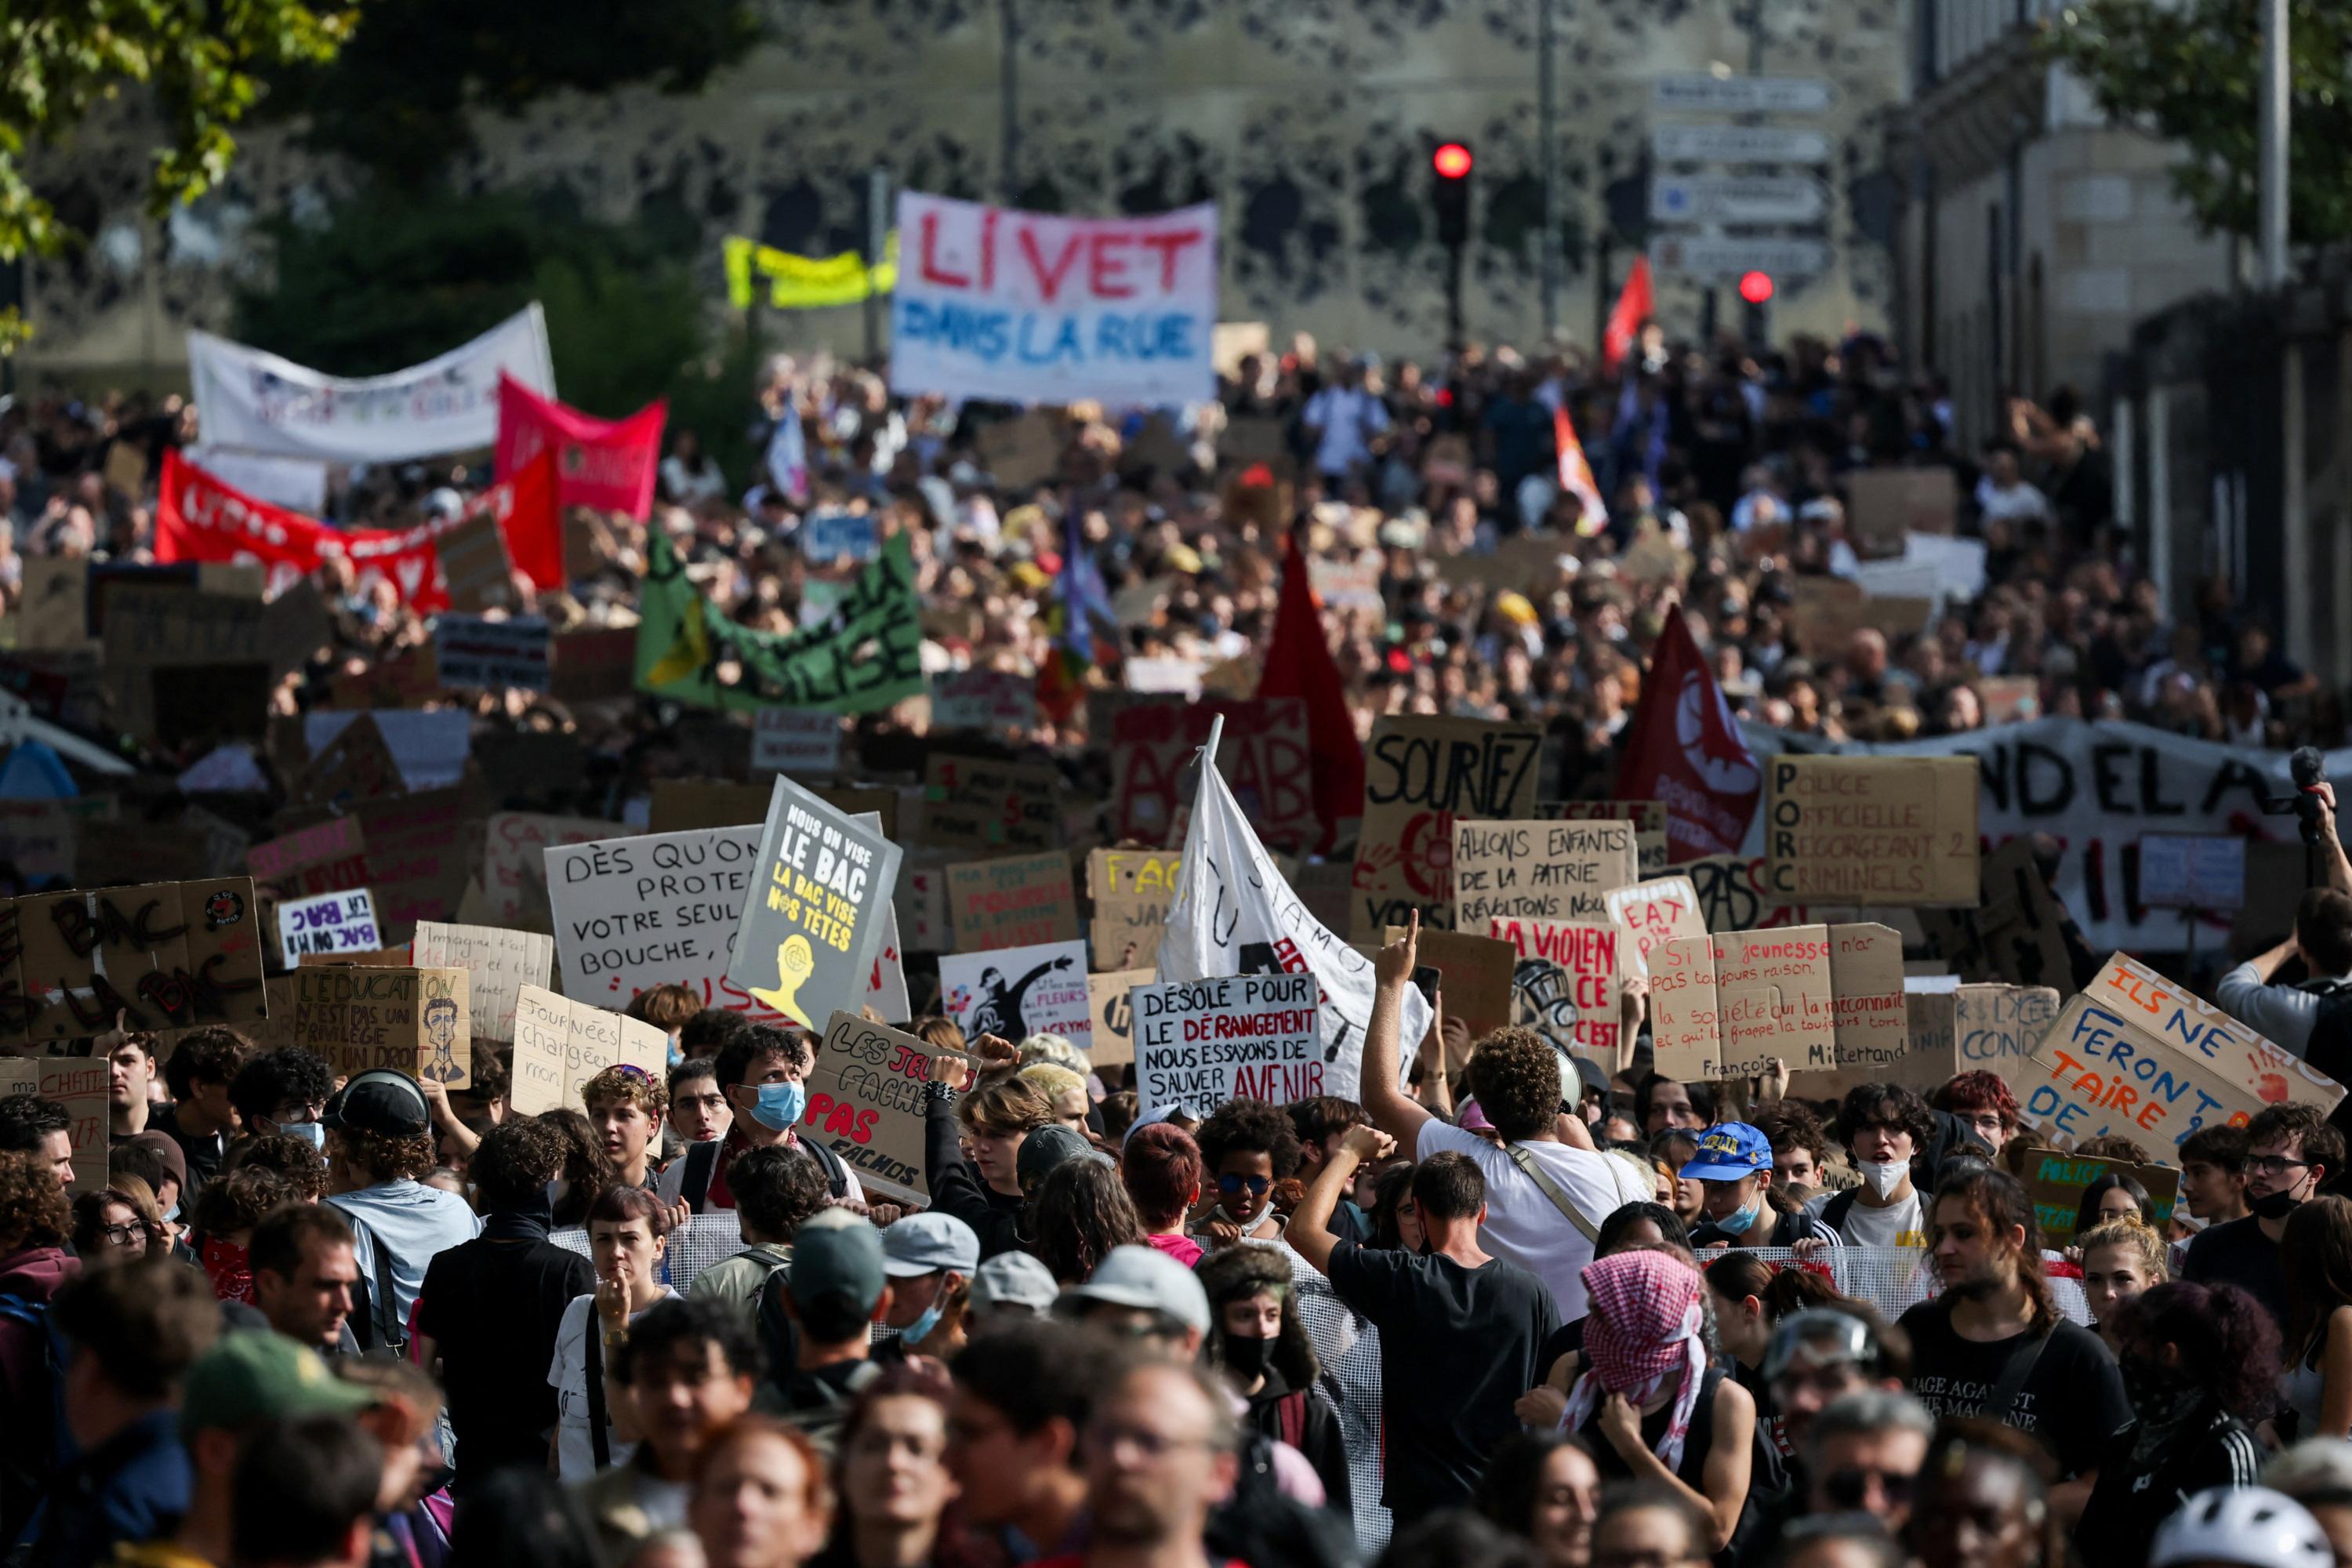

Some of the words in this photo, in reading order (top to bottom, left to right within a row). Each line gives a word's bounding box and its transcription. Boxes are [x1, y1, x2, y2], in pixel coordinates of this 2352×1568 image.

[920, 205, 1204, 304] LIVET
[902, 299, 1009, 362] DANS
[1018, 315, 1083, 364] LA
[1099, 315, 1194, 359] RUE
[1368, 731, 1541, 820] SOURIEZ
[787, 804, 822, 838] NOUS
[823, 826, 843, 851] ON
[844, 837, 873, 869] VISE
[1456, 828, 1530, 862] ALLONS
[1548, 827, 1628, 858] ENFANTS
[565, 843, 633, 883] DÈS
[779, 824, 811, 872] LE
[814, 845, 868, 905] BAC
[1461, 871, 1491, 891] DE
[1497, 867, 1517, 889] LA
[1773, 864, 1924, 892] CRIMINELS
[637, 869, 753, 902] PROTE
[772, 861, 791, 889] LA
[793, 873, 824, 907] BAC
[826, 892, 858, 927] VISE
[292, 901, 343, 931] BAC
[1570, 892, 1607, 918] NOU
[1624, 899, 1684, 929] EAT
[50, 896, 191, 958] BAC
[337, 924, 375, 947] BAC
[572, 909, 662, 942] VOTRE
[803, 906, 852, 953] TÊTES
[487, 958, 503, 971] et
[1665, 938, 1692, 967] Si
[1706, 938, 1725, 960] la
[1742, 942, 1831, 964] jeunesse
[135, 953, 263, 1024] BAC
[1036, 990, 1087, 1007] FLEURS
[1143, 980, 1232, 1017] DÉSOLÉ
[1245, 978, 1307, 1004] POUR
[1576, 975, 1608, 1009] CE
[1652, 971, 1687, 993] pas
[296, 1003, 347, 1024] N'EST
[350, 1005, 379, 1025] PAS
[385, 1008, 410, 1024] UN
[1658, 1002, 1675, 1025] la
[1691, 997, 1766, 1025] société
[1769, 1003, 1795, 1022] qui
[1802, 991, 1820, 1016] la
[2107, 967, 2169, 1014] ILS
[2165, 1007, 2236, 1058] NE
[1145, 1021, 1174, 1046] LE
[1183, 1008, 1316, 1042] DÉRANGEMENT
[1656, 1036, 1673, 1049] et
[1681, 1029, 1704, 1049] qui
[1710, 1026, 1724, 1041] la
[1730, 1024, 1776, 1045] frappe
[1779, 1018, 1795, 1033] la
[1801, 1015, 1860, 1033] toujours
[1962, 1027, 2044, 1060] COND
[342, 1046, 368, 1070] UN
[374, 1045, 430, 1069] DROIT
[522, 1023, 612, 1070] chargées
[830, 1022, 890, 1065] LES
[888, 1044, 978, 1093] JEUS
[1145, 1047, 1198, 1070] NOUS
[1202, 1041, 1277, 1065] ESSAYONS
[1283, 1039, 1308, 1060] DE
[1703, 1054, 1778, 1077] François
[1808, 1038, 1907, 1066] Mitterrand
[2071, 1007, 2223, 1114] FERONT
[12, 1080, 37, 1093] ma
[40, 1069, 109, 1094] CHATTE
[525, 1061, 561, 1087] mon
[1149, 1067, 1225, 1096] SAUVER
[1232, 1060, 1325, 1105] AVENIR
[804, 1092, 880, 1145] PAS
[2027, 1083, 2090, 1135] DE
[828, 1138, 920, 1187] FACHOS
[1911, 1376, 1947, 1394] RAGE
[1918, 1396, 1942, 1410] HE
